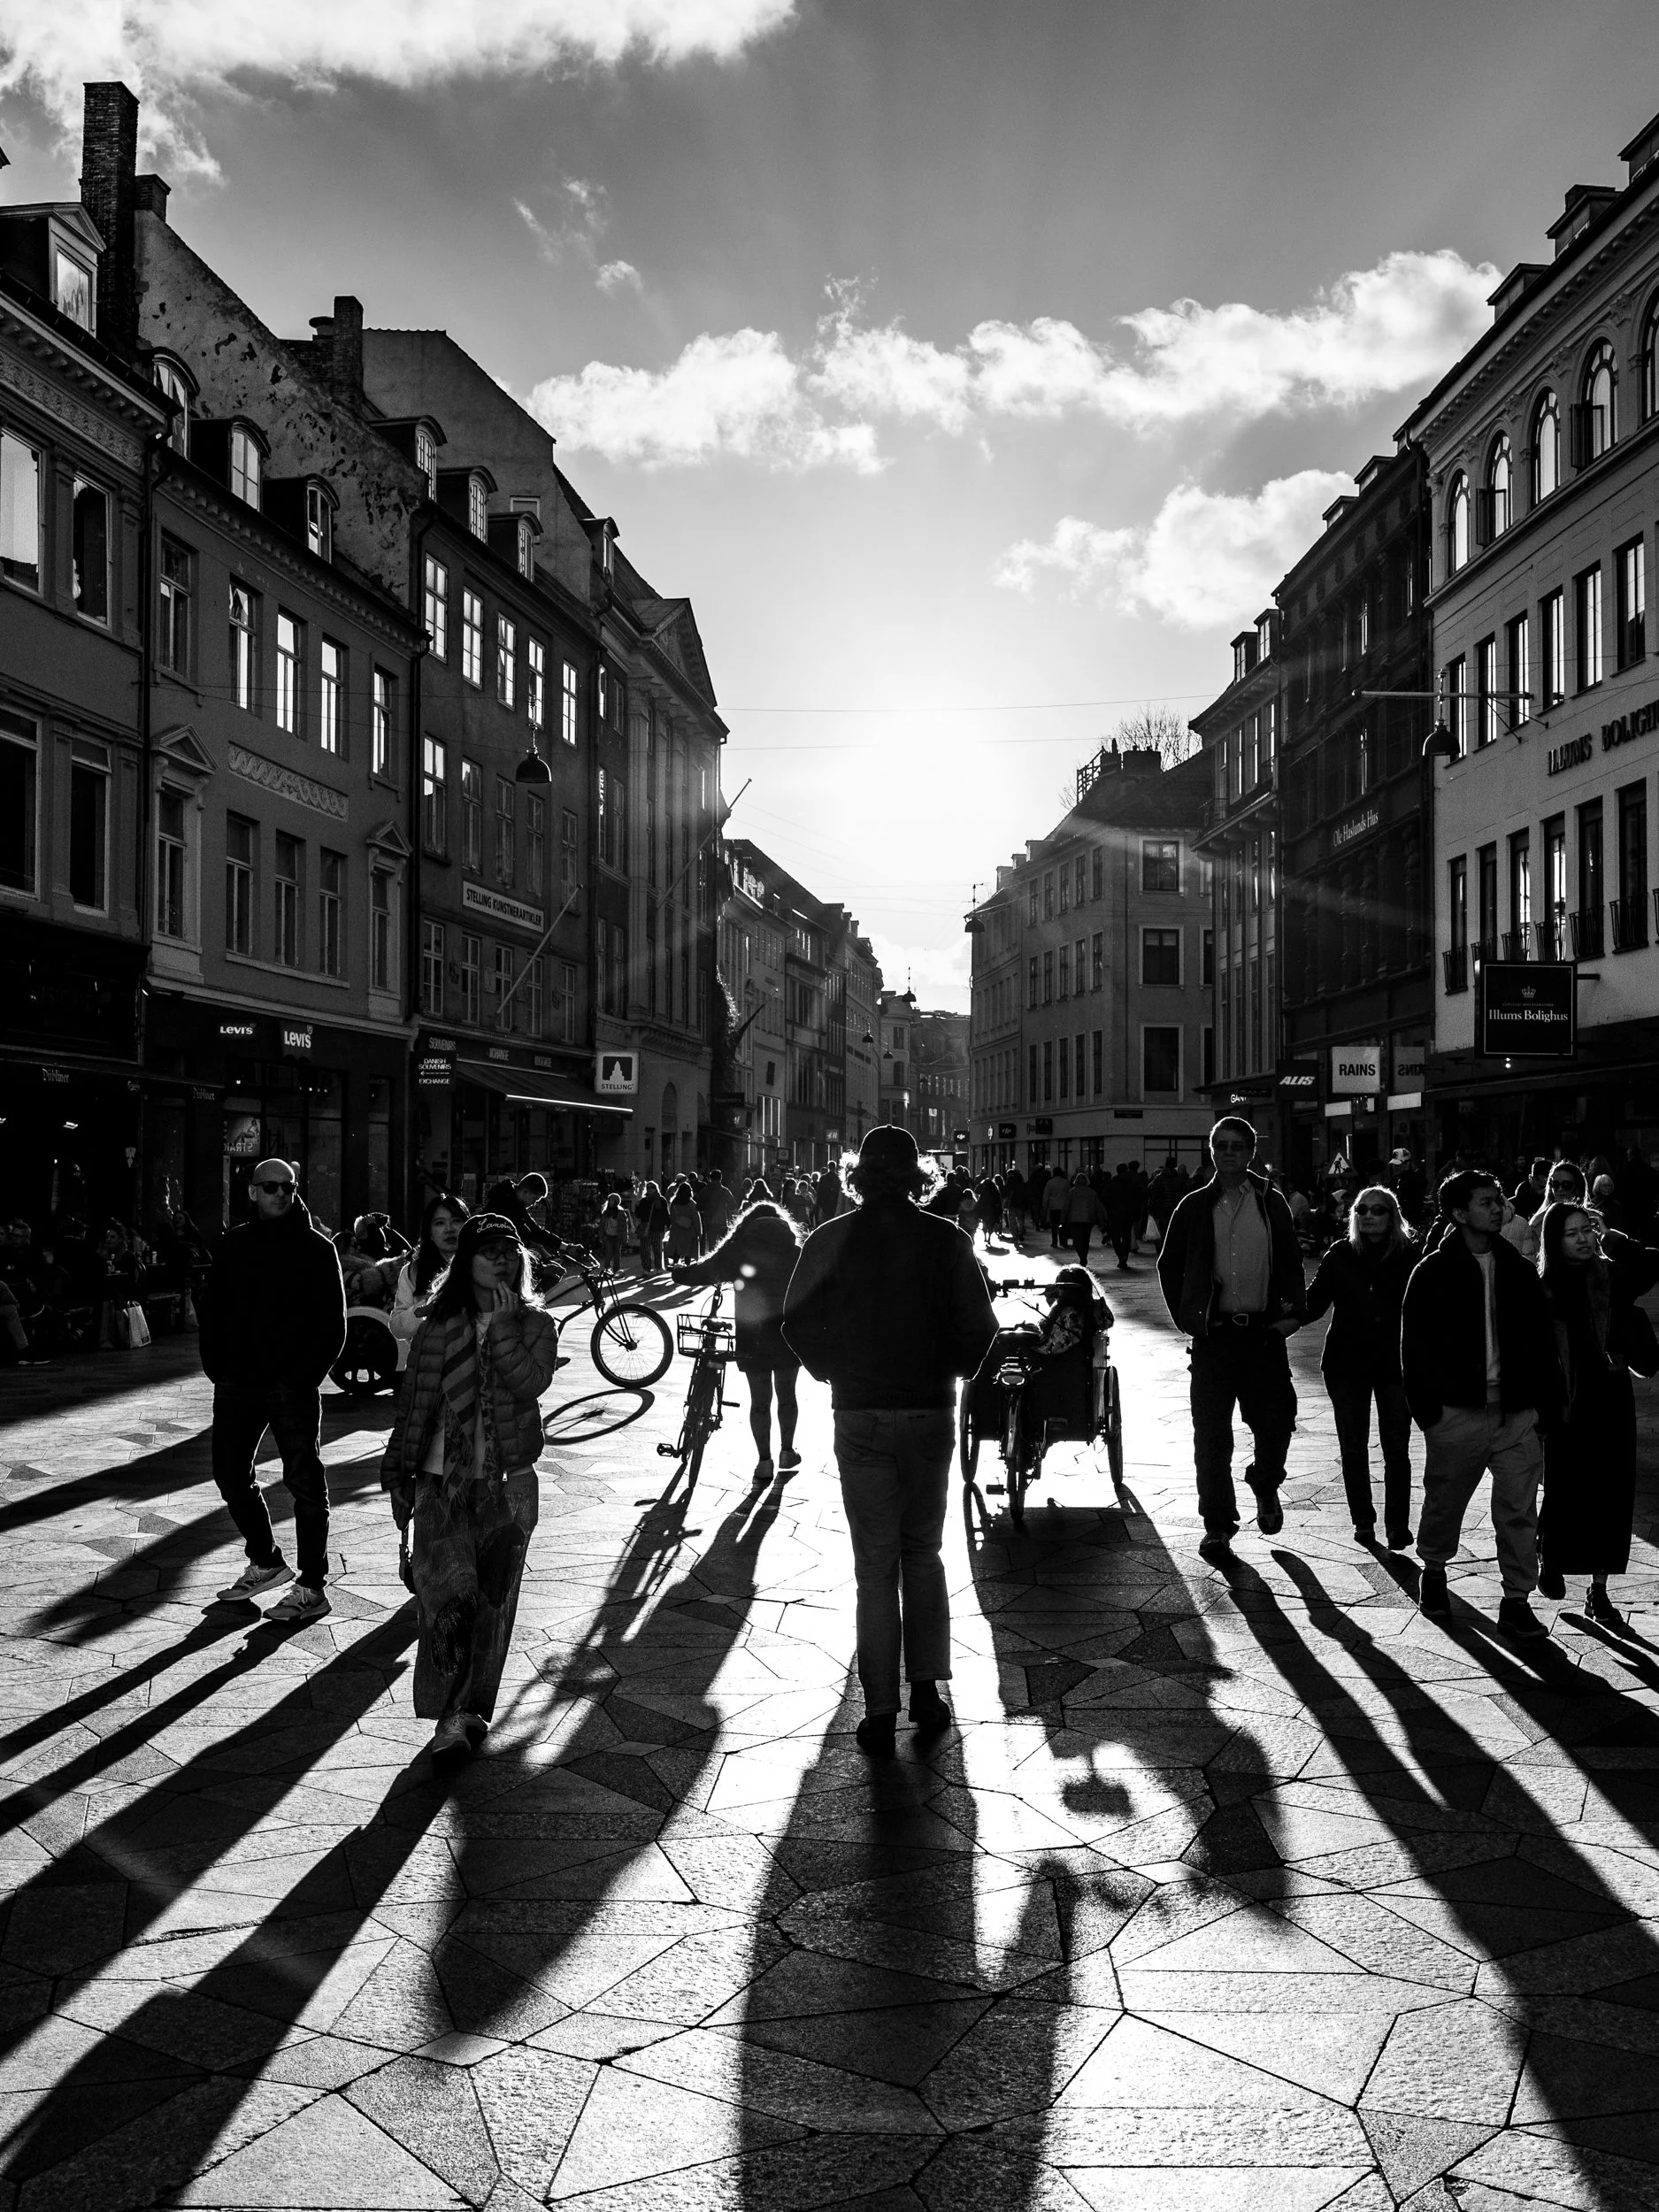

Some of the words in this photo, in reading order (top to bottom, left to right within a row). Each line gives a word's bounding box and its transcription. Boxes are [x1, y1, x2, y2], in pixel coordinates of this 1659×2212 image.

[1547, 733, 1592, 776] ILLUMS
[1601, 699, 1659, 751] BOLIGH
[1367, 809, 1379, 828] Hus
[466, 888, 492, 909] STELLING
[493, 898, 541, 926] KUNSTNERARTIKLER
[1489, 1010, 1522, 1020] Illums
[1525, 1010, 1569, 1023] Bolighus
[1339, 1064, 1376, 1076] RAINS
[1279, 1076, 1316, 1086] ALIS
